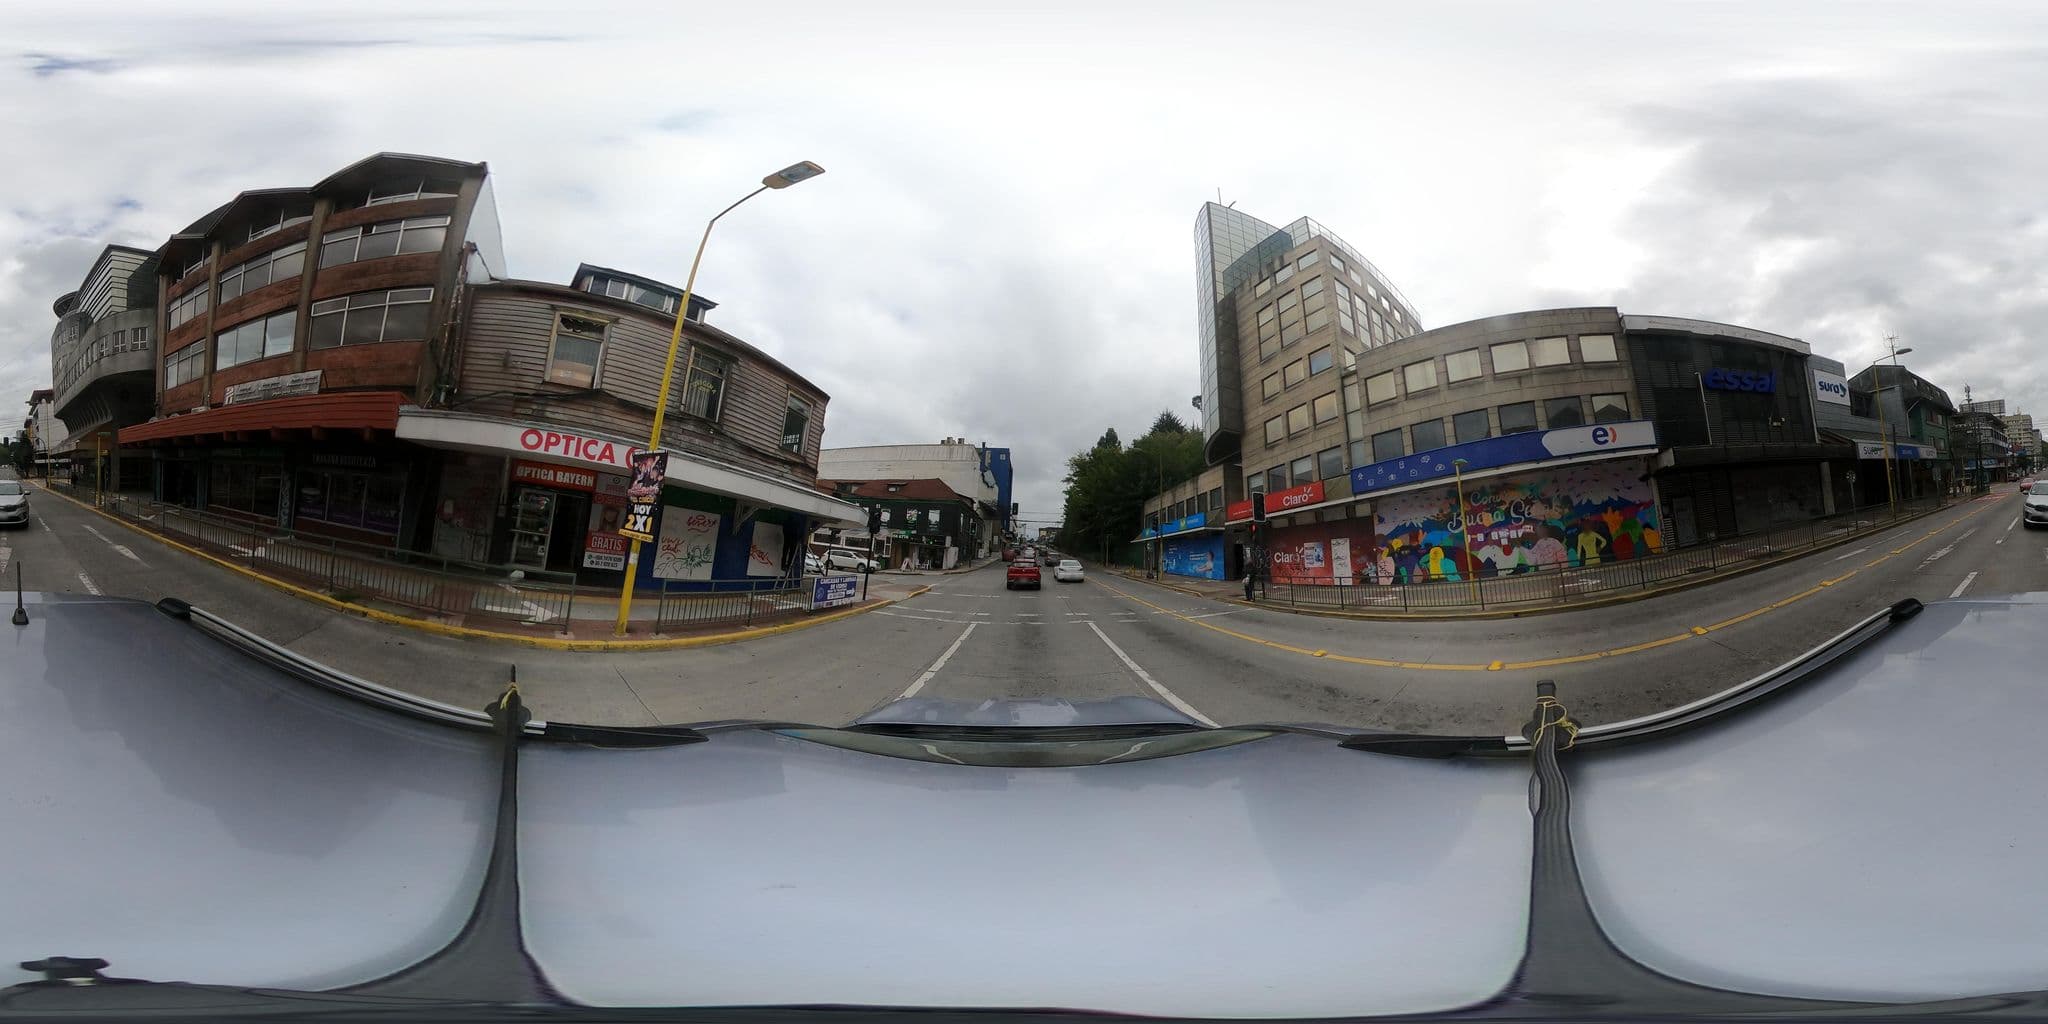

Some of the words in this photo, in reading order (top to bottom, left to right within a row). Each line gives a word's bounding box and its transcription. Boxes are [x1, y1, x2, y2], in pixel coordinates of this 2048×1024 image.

[1705, 368, 1776, 393] essal
[1818, 379, 1840, 394] sura
[520, 428, 616, 464] OPTICA
[516, 466, 555, 482] OPTICA
[556, 472, 595, 487] BAYERN
[1282, 492, 1309, 507] Claro
[633, 504, 652, 515] HOY
[625, 514, 653, 533] 2X1
[591, 536, 623, 551] GRATIS
[1273, 552, 1300, 563] Claro
